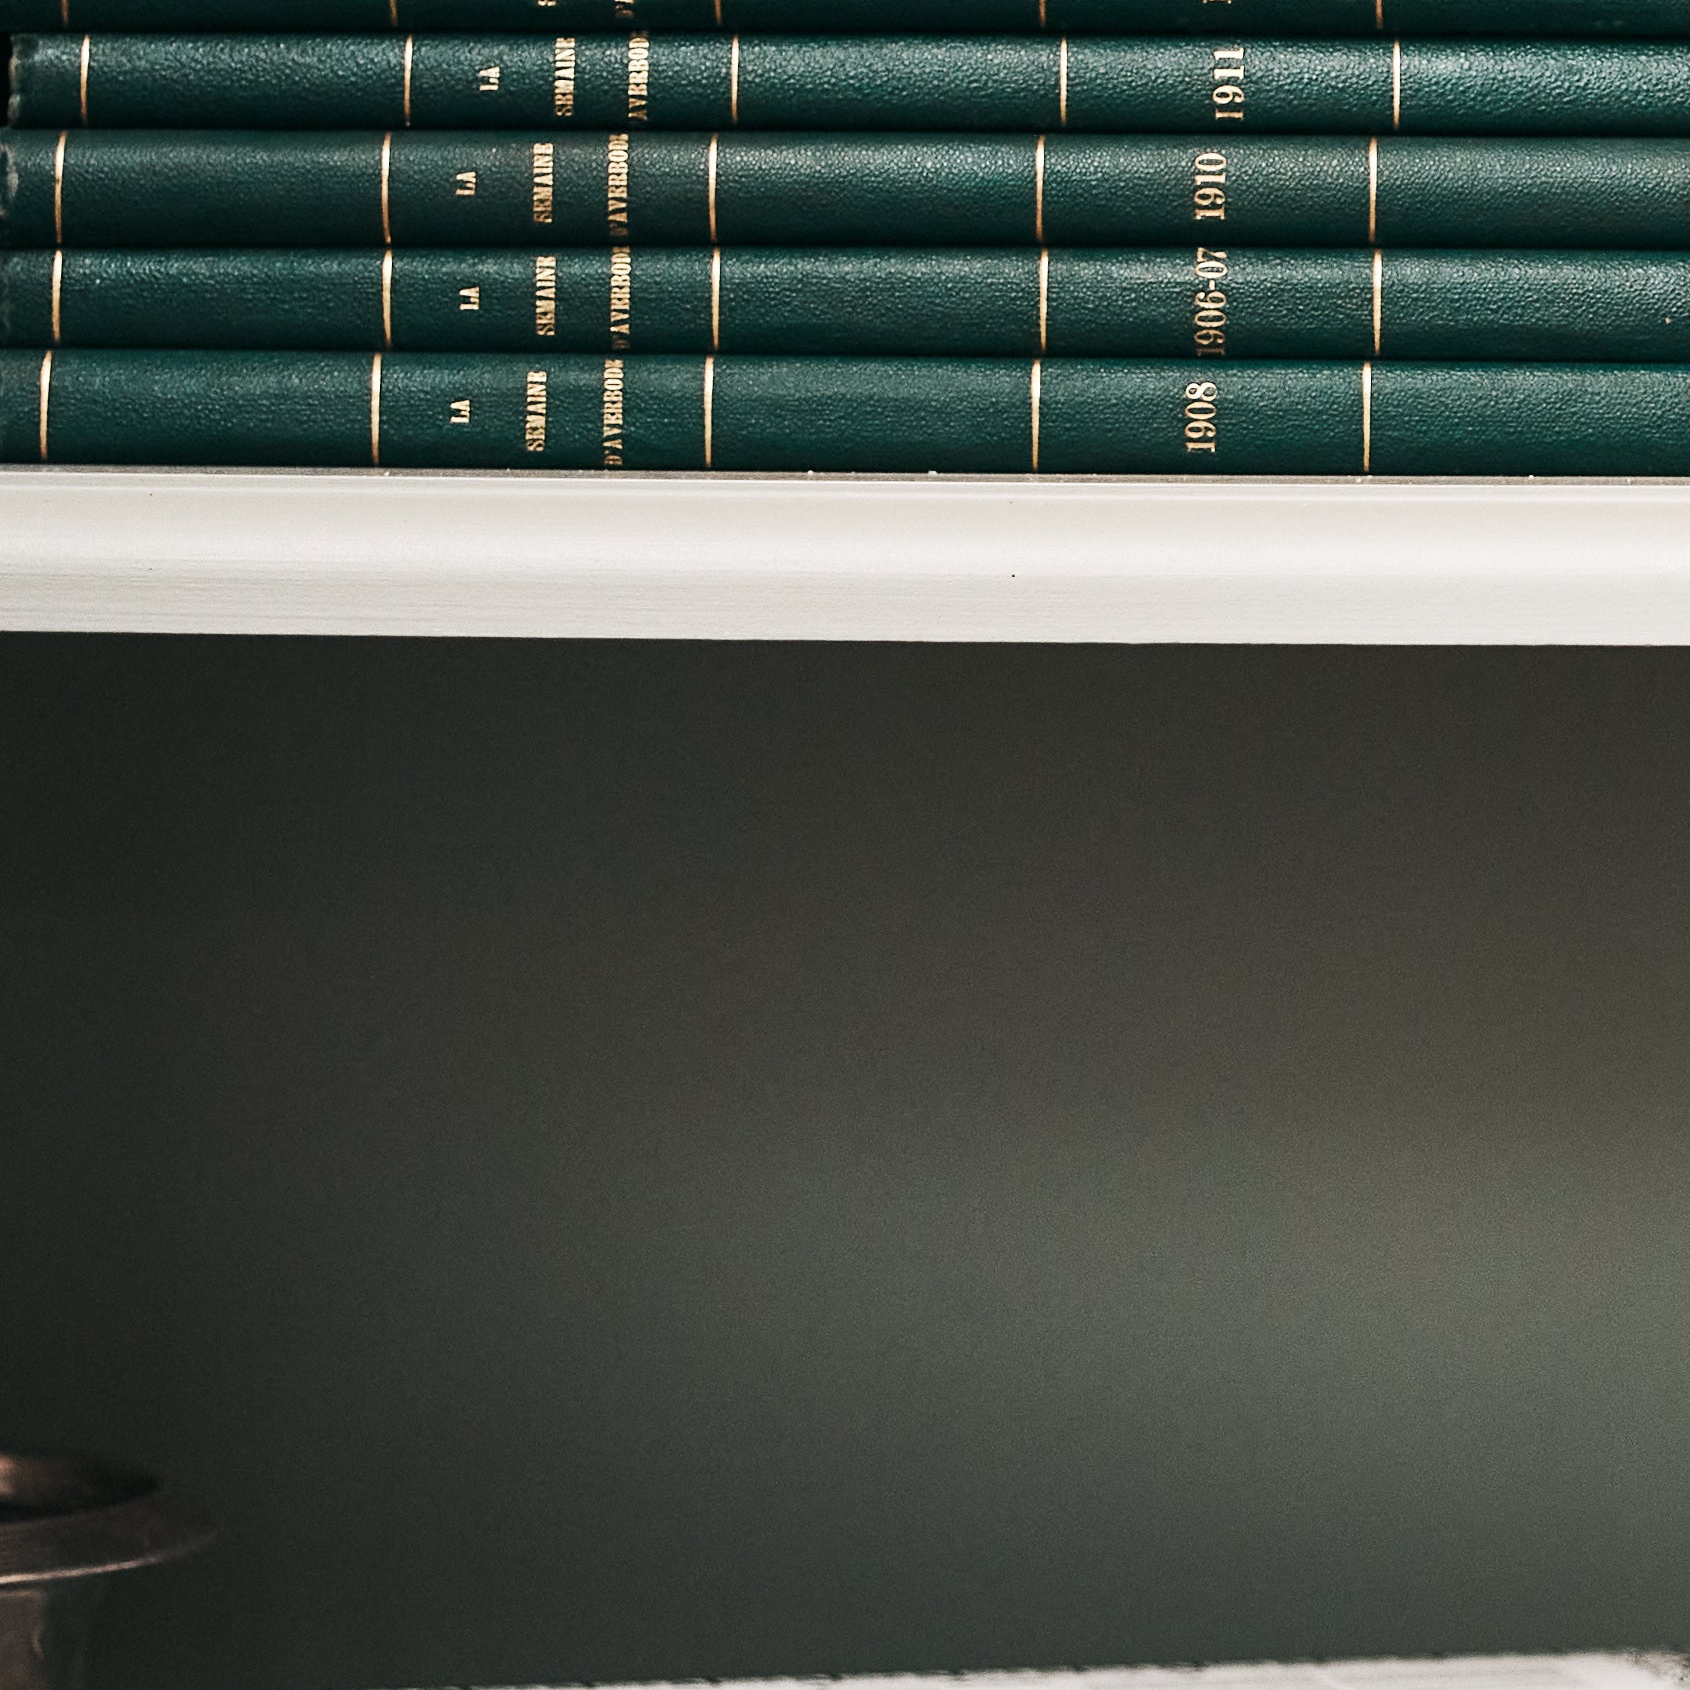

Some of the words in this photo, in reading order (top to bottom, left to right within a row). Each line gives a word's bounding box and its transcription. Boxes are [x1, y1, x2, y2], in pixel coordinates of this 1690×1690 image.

[479, 67, 500, 91] LA
[554, 38, 576, 116] SEMAINE
[1213, 48, 1245, 120] 1911
[456, 171, 476, 195] LA
[533, 143, 553, 223] SEMAINE
[1194, 152, 1226, 219] 1910
[459, 287, 479, 310] LA
[535, 256, 556, 335] SEMAINE
[1194, 247, 1227, 355] 1906-07
[450, 400, 470, 423] LA
[526, 371, 546, 451] SEMAINE
[1185, 382, 1217, 452] 1908
